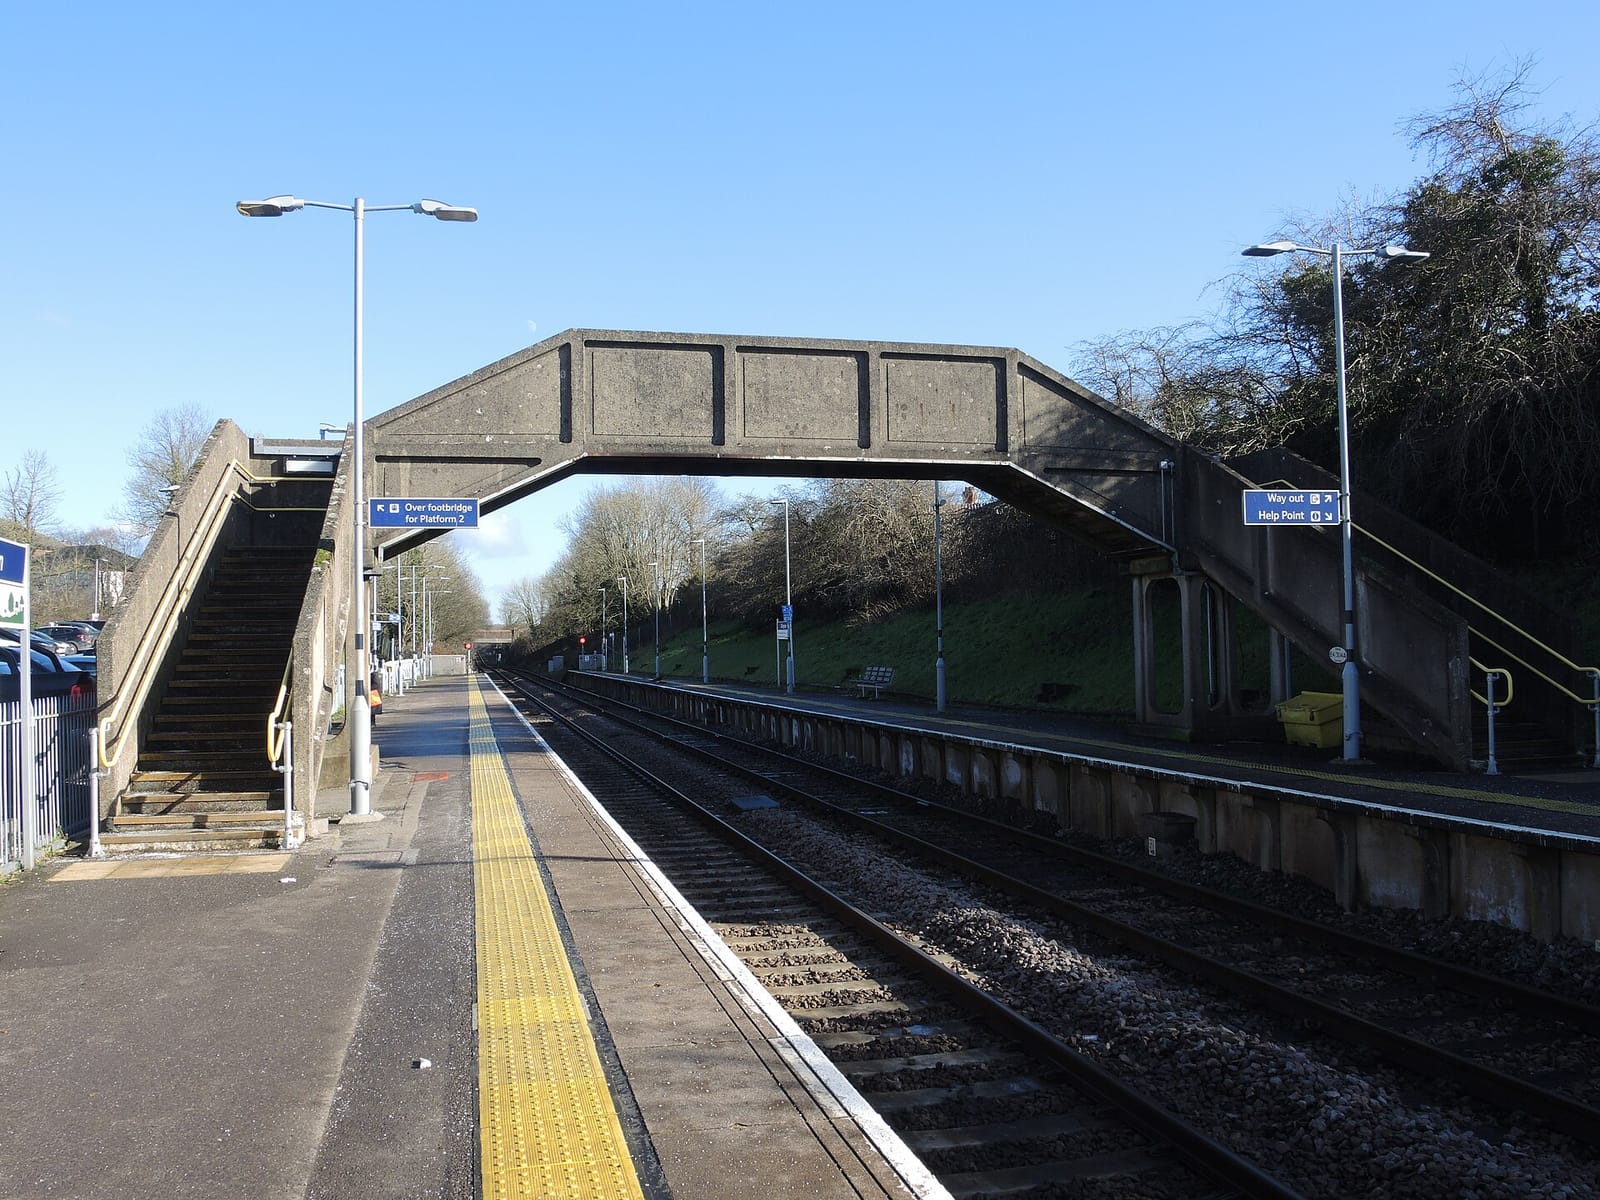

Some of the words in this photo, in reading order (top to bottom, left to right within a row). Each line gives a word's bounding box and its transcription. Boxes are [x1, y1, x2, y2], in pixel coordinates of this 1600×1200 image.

[1267, 493, 1286, 504] Way
[1289, 494, 1304, 502] out
[405, 503, 425, 511] Over
[428, 503, 472, 513] footbridge
[405, 515, 417, 523] for
[420, 515, 456, 523] Platform
[459, 515, 464, 523] 2
[1258, 511, 1279, 522] Help
[1282, 511, 1304, 520] Point
